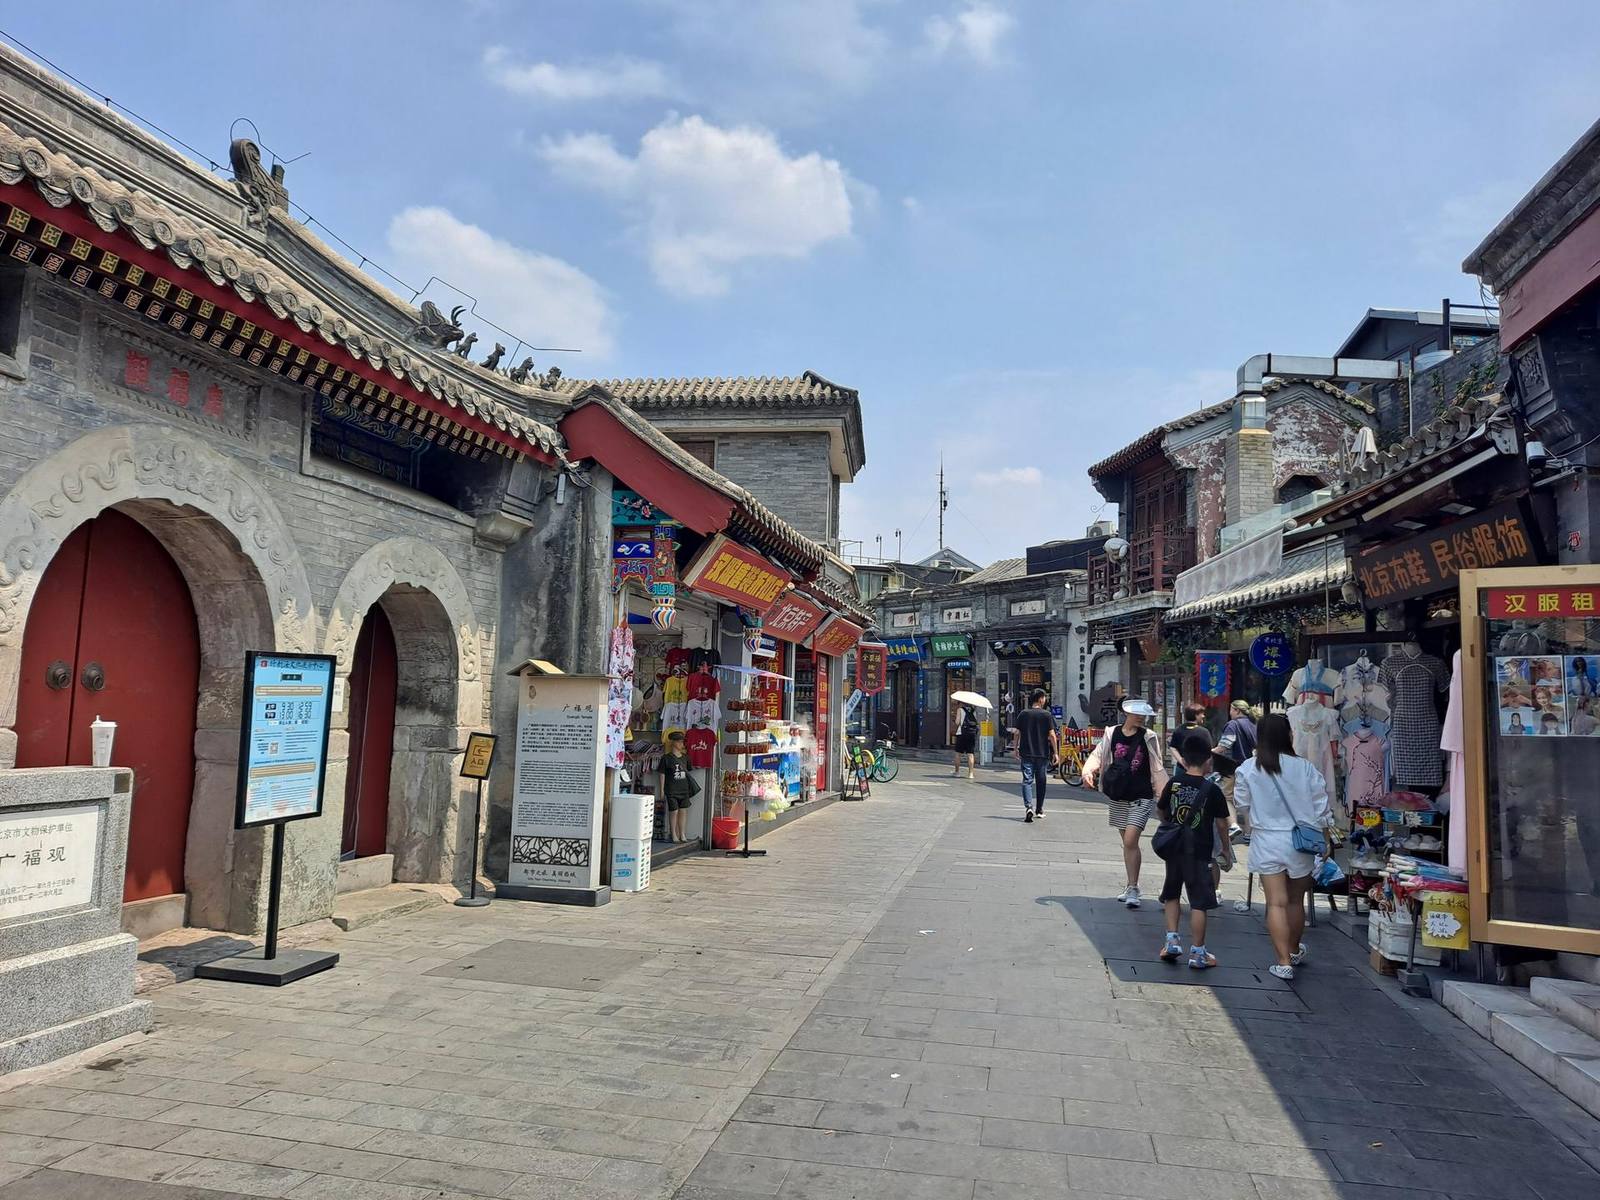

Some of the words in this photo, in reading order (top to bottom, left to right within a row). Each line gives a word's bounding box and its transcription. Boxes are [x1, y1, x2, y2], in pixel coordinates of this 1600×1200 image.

[1360, 550, 1431, 599] 北京布鞋
[1430, 515, 1527, 578] 民俗服饰
[1504, 592, 1595, 613] 汉服租
[470, 758, 484, 766] 入口
